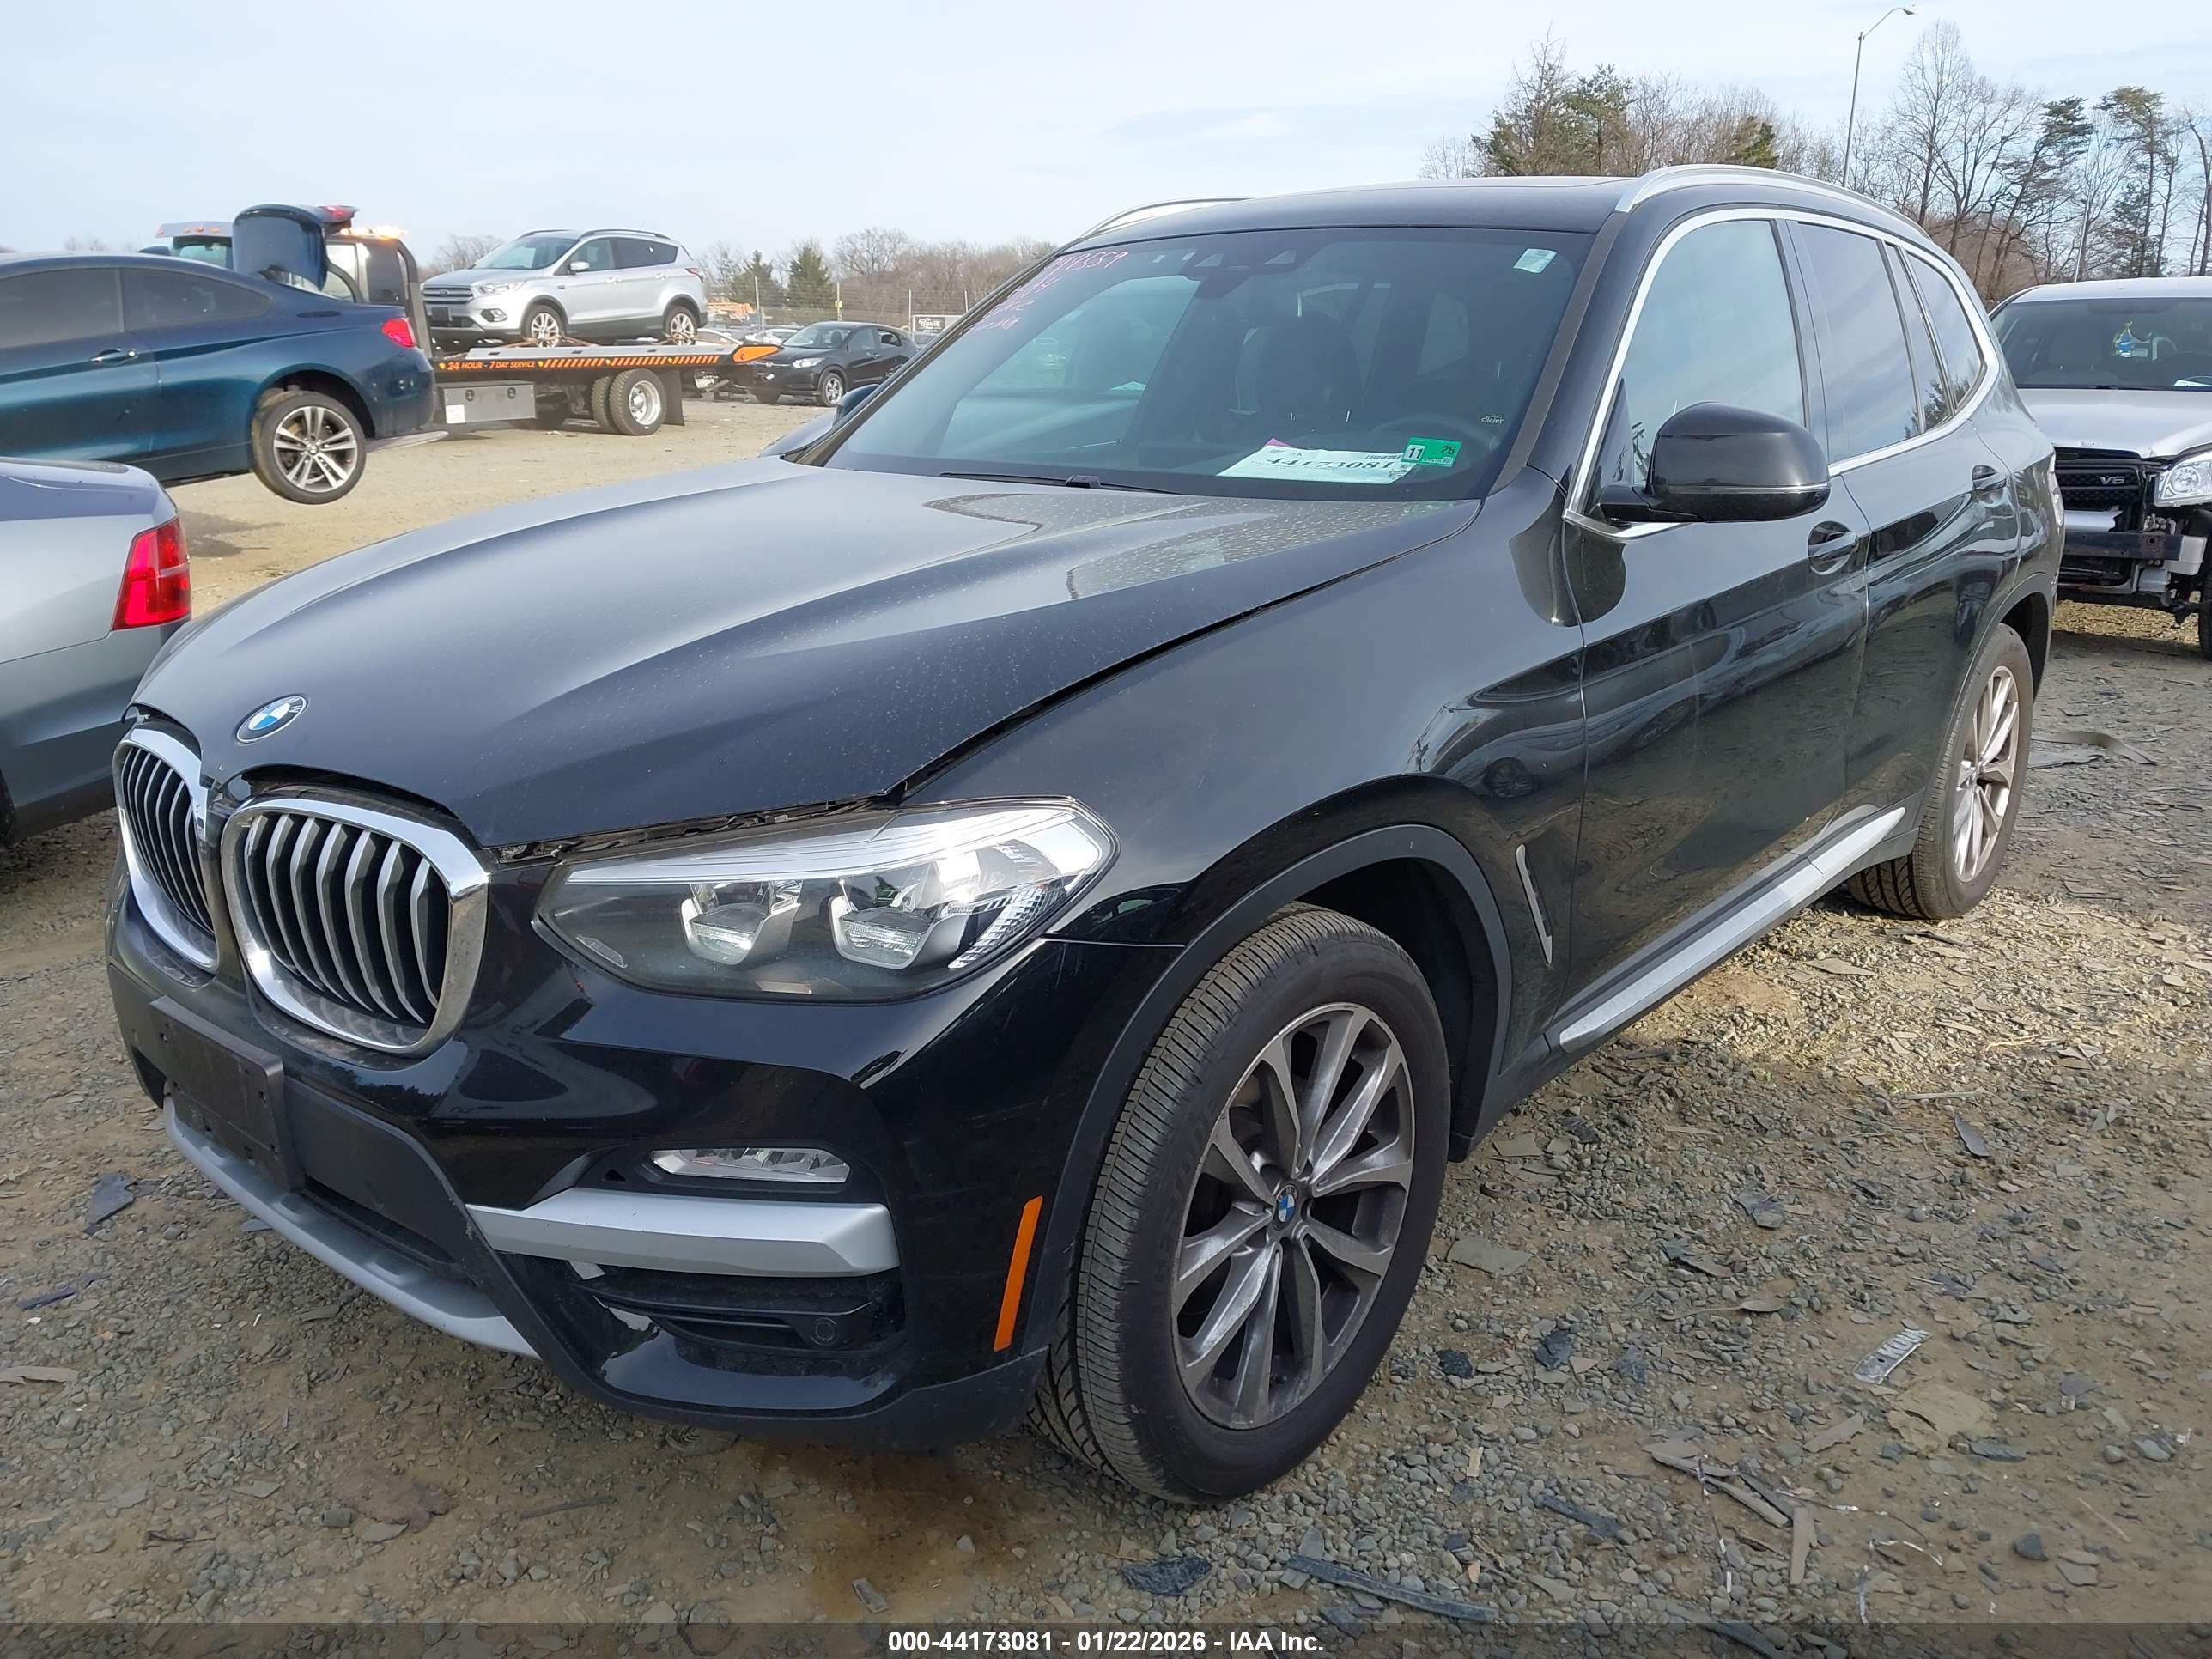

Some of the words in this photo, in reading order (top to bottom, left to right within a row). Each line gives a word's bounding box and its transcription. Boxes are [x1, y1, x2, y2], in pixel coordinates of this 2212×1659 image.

[447, 362, 460, 371] 24
[461, 362, 483, 370] HOUR
[489, 361, 495, 370] 7
[495, 361, 511, 369] DAY
[510, 361, 537, 369] SERVICE
[1408, 447, 1424, 459] 11
[1440, 445, 1457, 455] 26
[2100, 476, 2125, 485] V6
